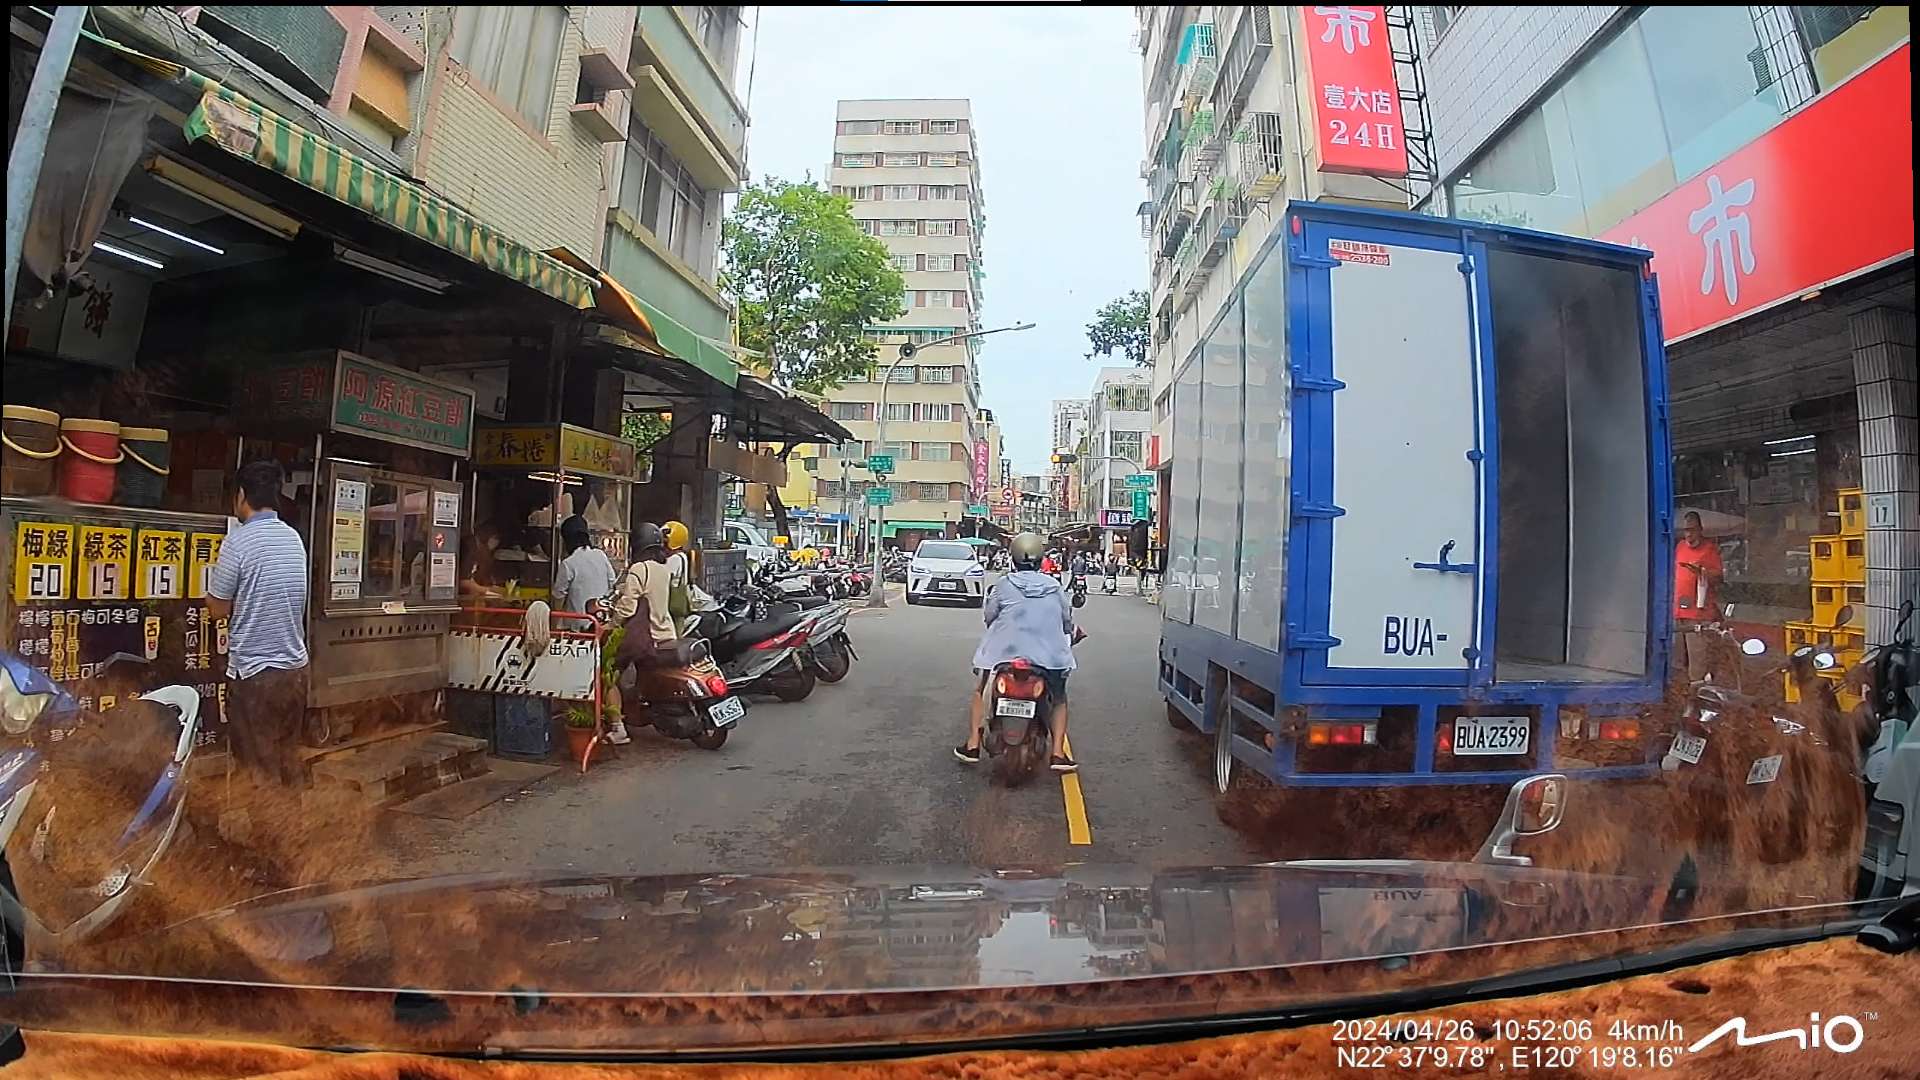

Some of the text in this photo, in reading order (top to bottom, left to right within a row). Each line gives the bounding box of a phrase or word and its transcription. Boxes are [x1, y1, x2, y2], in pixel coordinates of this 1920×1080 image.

[1324, 84, 1392, 115] 壹大店
[1329, 119, 1396, 149] 24H
[1689, 175, 1756, 306] 市
[1876, 507, 1887, 523] 17
[22, 528, 69, 559] 梅綠
[83, 532, 128, 561] 綠茶
[141, 535, 182, 562] 紅茶
[195, 539, 223, 562] 青
[31, 564, 61, 597] 20
[92, 564, 117, 597] 15
[151, 566, 170, 596] 15
[1384, 617, 1447, 656] BUA-
